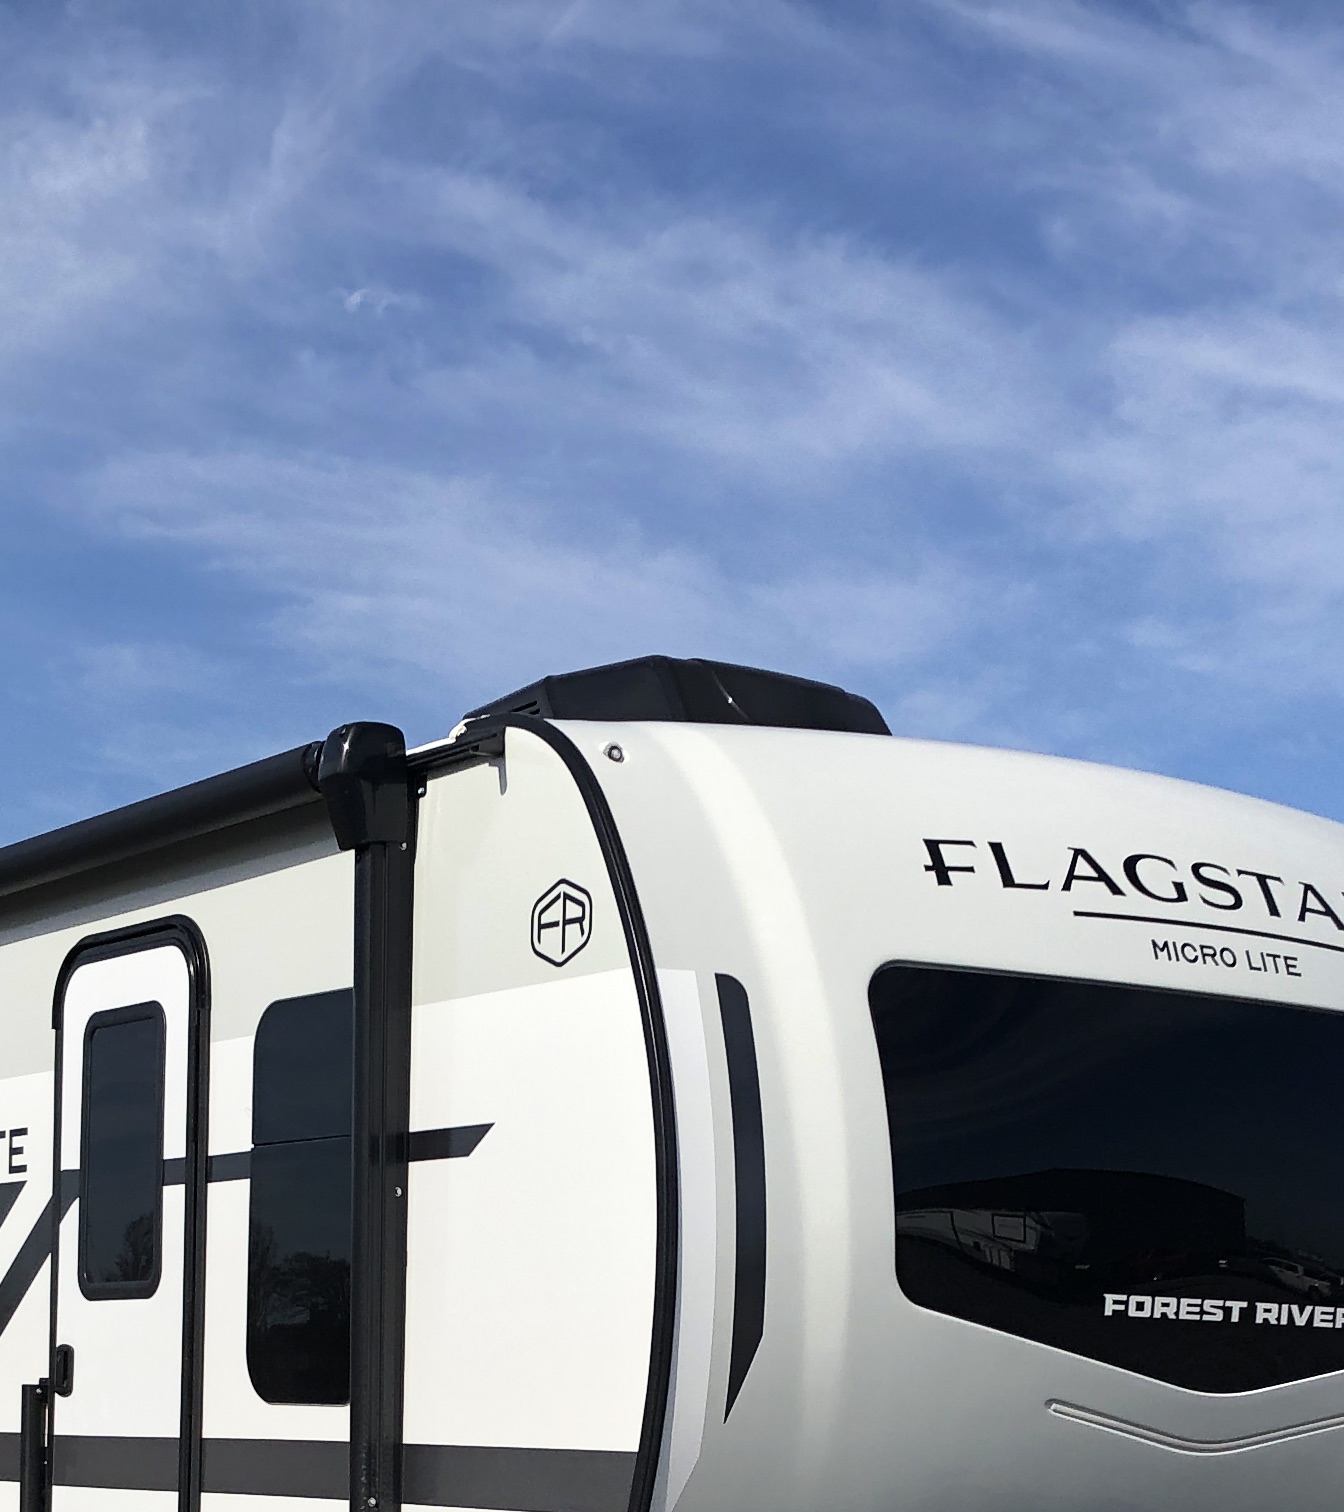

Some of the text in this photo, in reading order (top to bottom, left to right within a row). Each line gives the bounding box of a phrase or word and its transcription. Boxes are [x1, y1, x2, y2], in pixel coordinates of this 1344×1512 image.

[1151, 938, 1302, 977] MICRO LITE
[1103, 1293, 1248, 1323] FOREST
